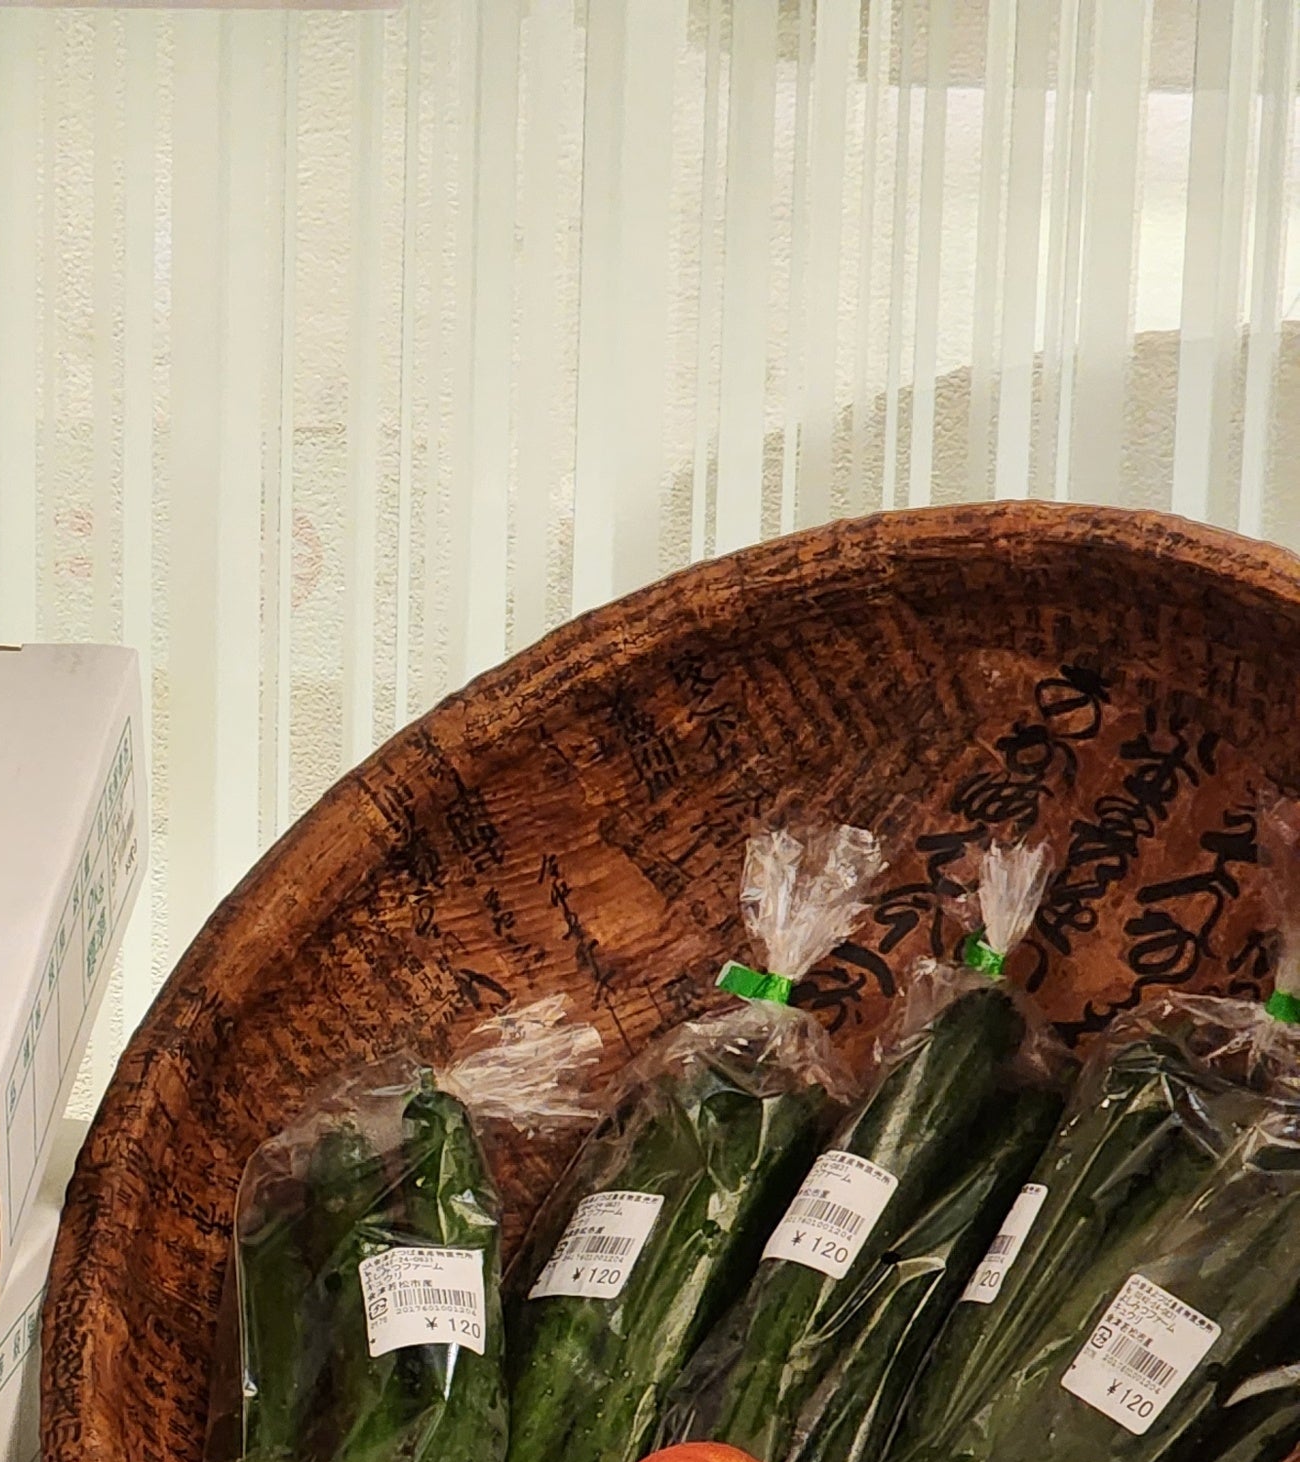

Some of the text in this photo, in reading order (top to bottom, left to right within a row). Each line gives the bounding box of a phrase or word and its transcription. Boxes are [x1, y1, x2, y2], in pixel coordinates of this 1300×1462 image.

[791, 1230, 849, 1263] ¥ 120
[588, 1268, 621, 1285] 120
[425, 1317, 480, 1339] ¥ 120
[1107, 1378, 1155, 1418] ¥ 120
